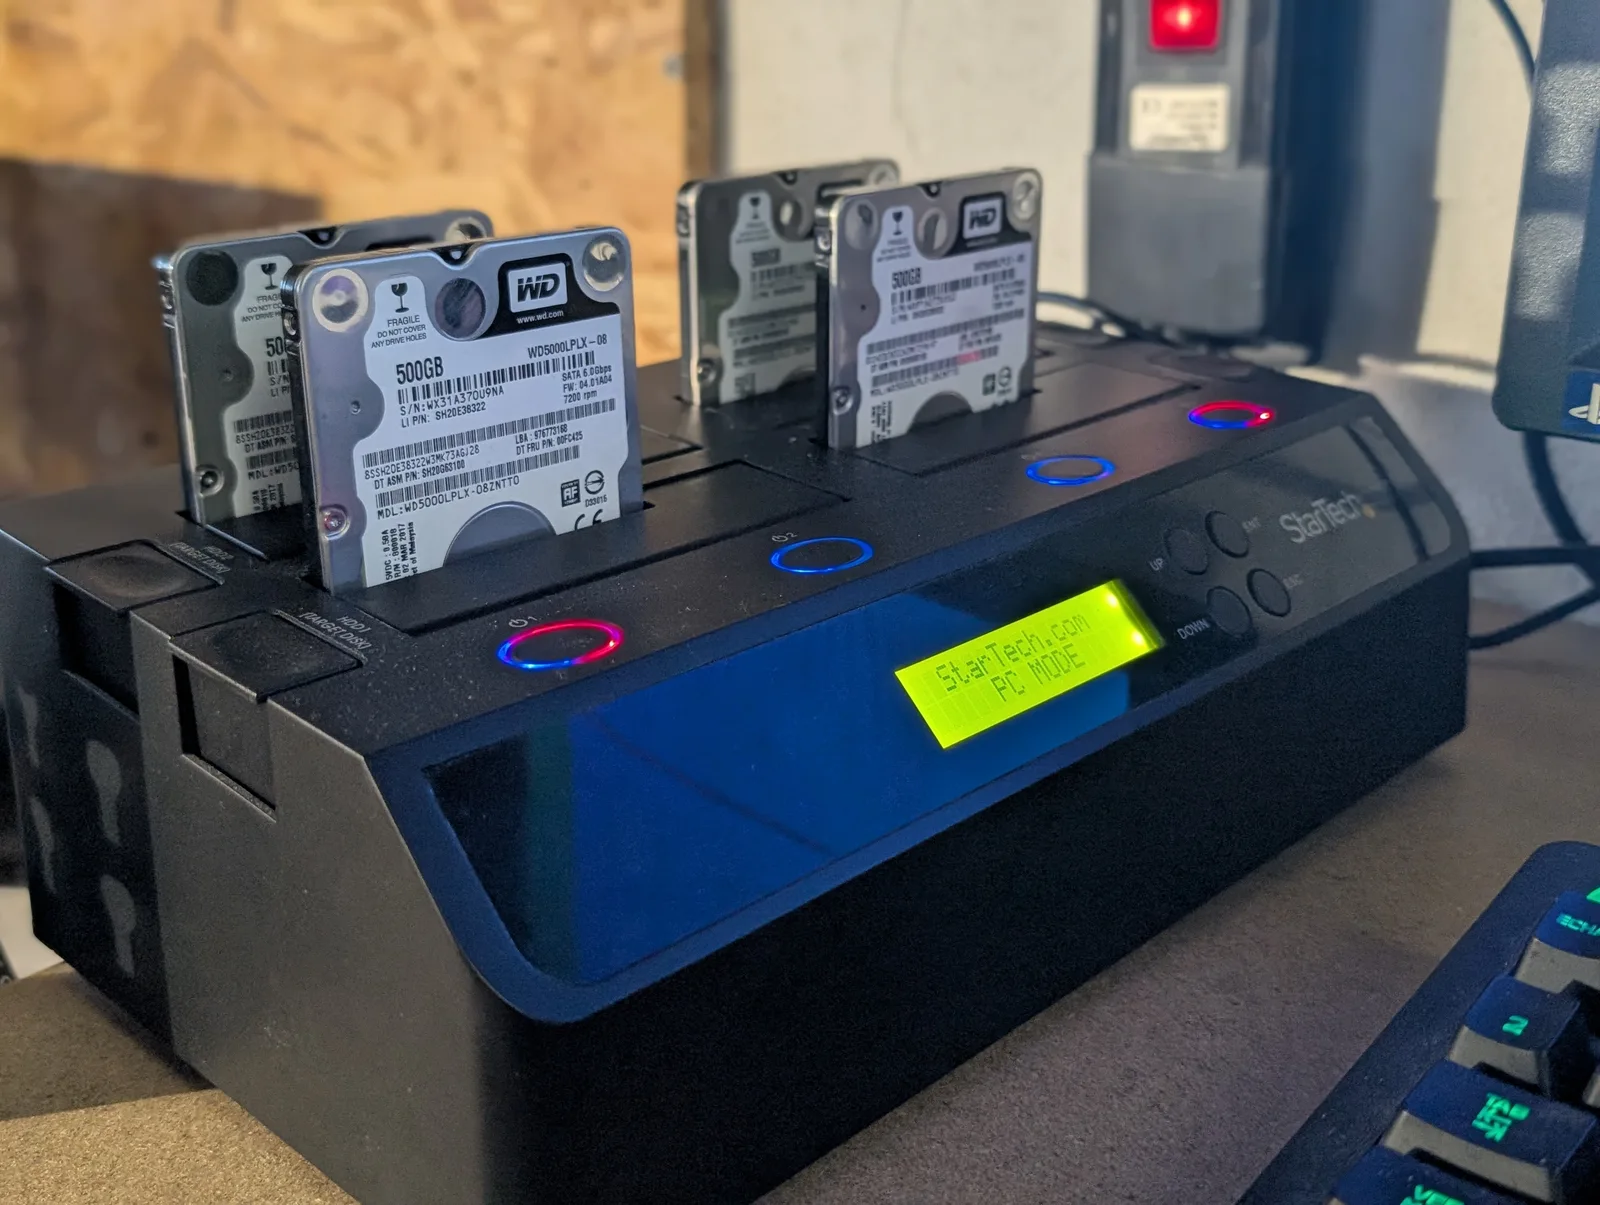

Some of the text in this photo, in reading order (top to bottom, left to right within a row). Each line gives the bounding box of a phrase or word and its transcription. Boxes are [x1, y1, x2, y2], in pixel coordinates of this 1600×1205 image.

[517, 273, 560, 302] WD
[387, 315, 420, 327] FRAGILE
[516, 310, 564, 324] www.wd.com
[389, 328, 402, 336] NOT
[403, 324, 426, 334] COVER
[385, 337, 405, 346] DRIVE
[405, 333, 427, 342] HOLES
[396, 356, 444, 385] 500GB
[562, 364, 612, 382] SATA 6.0Gbps
[563, 383, 578, 393] FW:
[563, 390, 597, 404] 7200 rpm
[401, 401, 486, 428] LI P/N: SH20E38322
[515, 435, 528, 445] LBA
[516, 445, 525, 455] DT
[527, 441, 540, 452] FRU
[374, 479, 385, 490] DT
[387, 474, 403, 487] ASM
[563, 486, 578, 501] AF
[398, 523, 407, 542] 2017
[400, 543, 408, 562] MAR
[1149, 557, 1165, 573] UP
[336, 615, 372, 633] HDD1
[1176, 618, 1210, 640] DOWN
[935, 614, 1091, 692] StarTech.com
[991, 643, 1085, 703] PC MODE
